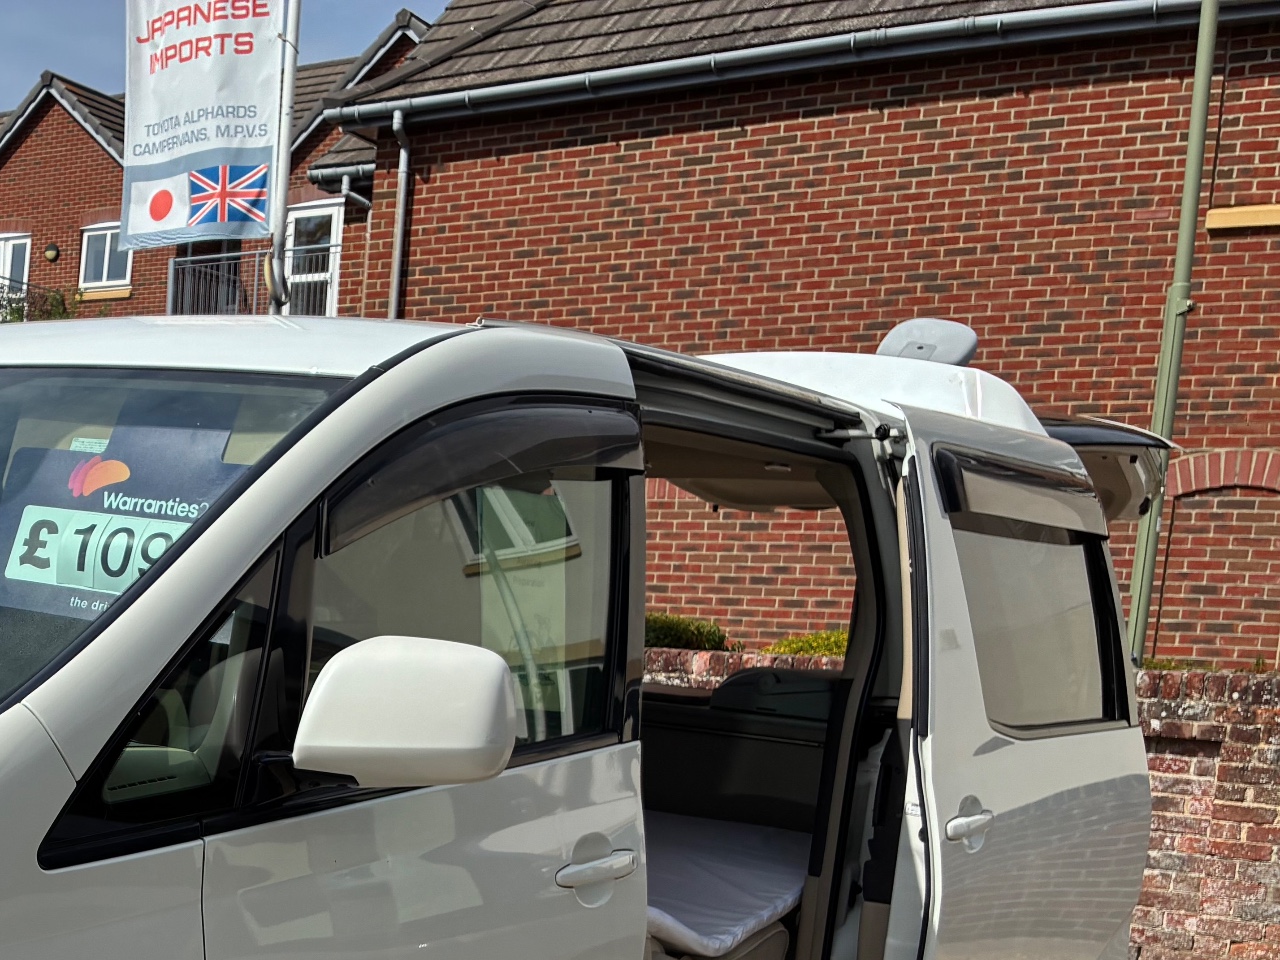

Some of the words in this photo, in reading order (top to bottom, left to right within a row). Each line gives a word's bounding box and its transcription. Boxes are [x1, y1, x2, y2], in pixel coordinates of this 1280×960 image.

[136, 0, 270, 43] JAPANESE
[150, 32, 254, 75] IMPORTS
[144, 117, 182, 137] TOYOTA
[183, 105, 257, 125] ALPHARDS
[215, 124, 268, 138] M.P.V.S
[69, 596, 88, 609] the
